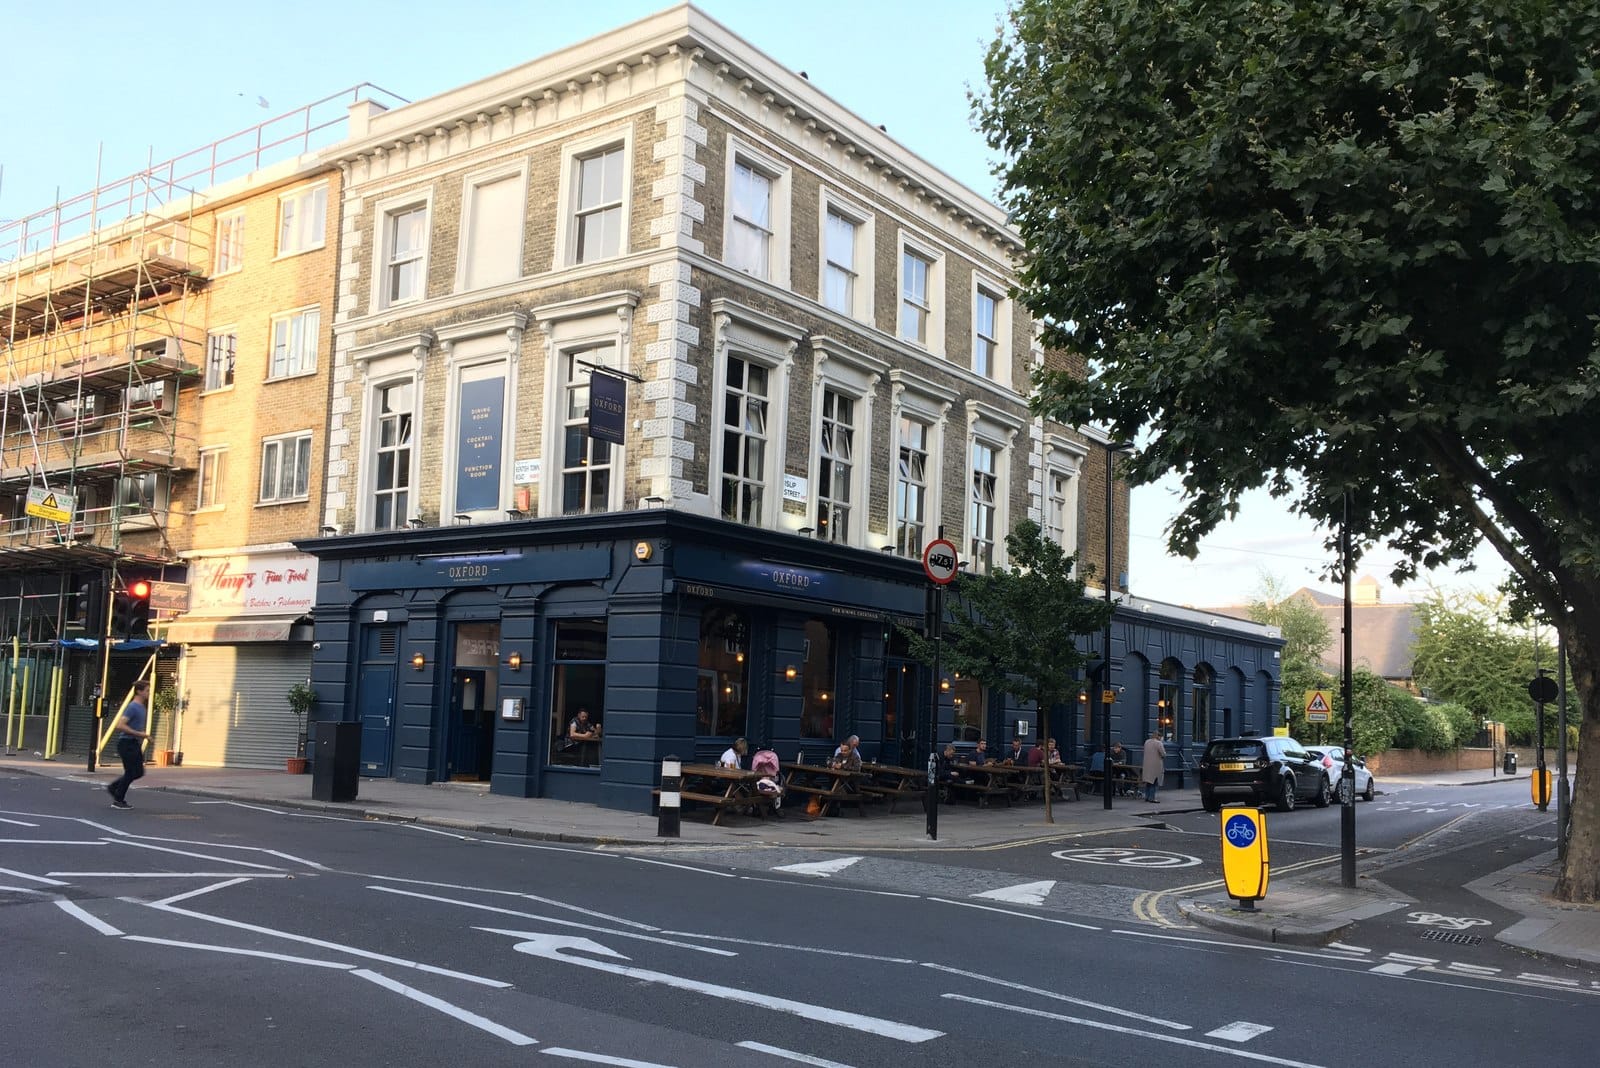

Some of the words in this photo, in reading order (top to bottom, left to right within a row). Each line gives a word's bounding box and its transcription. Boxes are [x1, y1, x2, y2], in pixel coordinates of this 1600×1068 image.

[471, 406, 491, 415] DINING
[594, 398, 623, 414] OXFORD
[472, 413, 489, 421] ROOM
[466, 435, 493, 444] COCKTAIL
[464, 464, 493, 473] FUNCTION
[783, 488, 801, 498] STREET
[262, 569, 282, 585] Fine
[285, 567, 310, 584] Food
[449, 565, 488, 578] OXFORD
[772, 570, 810, 587] OXFORD
[687, 584, 714, 597] OXFORD
[276, 597, 312, 609] Fishmonger
[1069, 850, 1182, 866] 20
